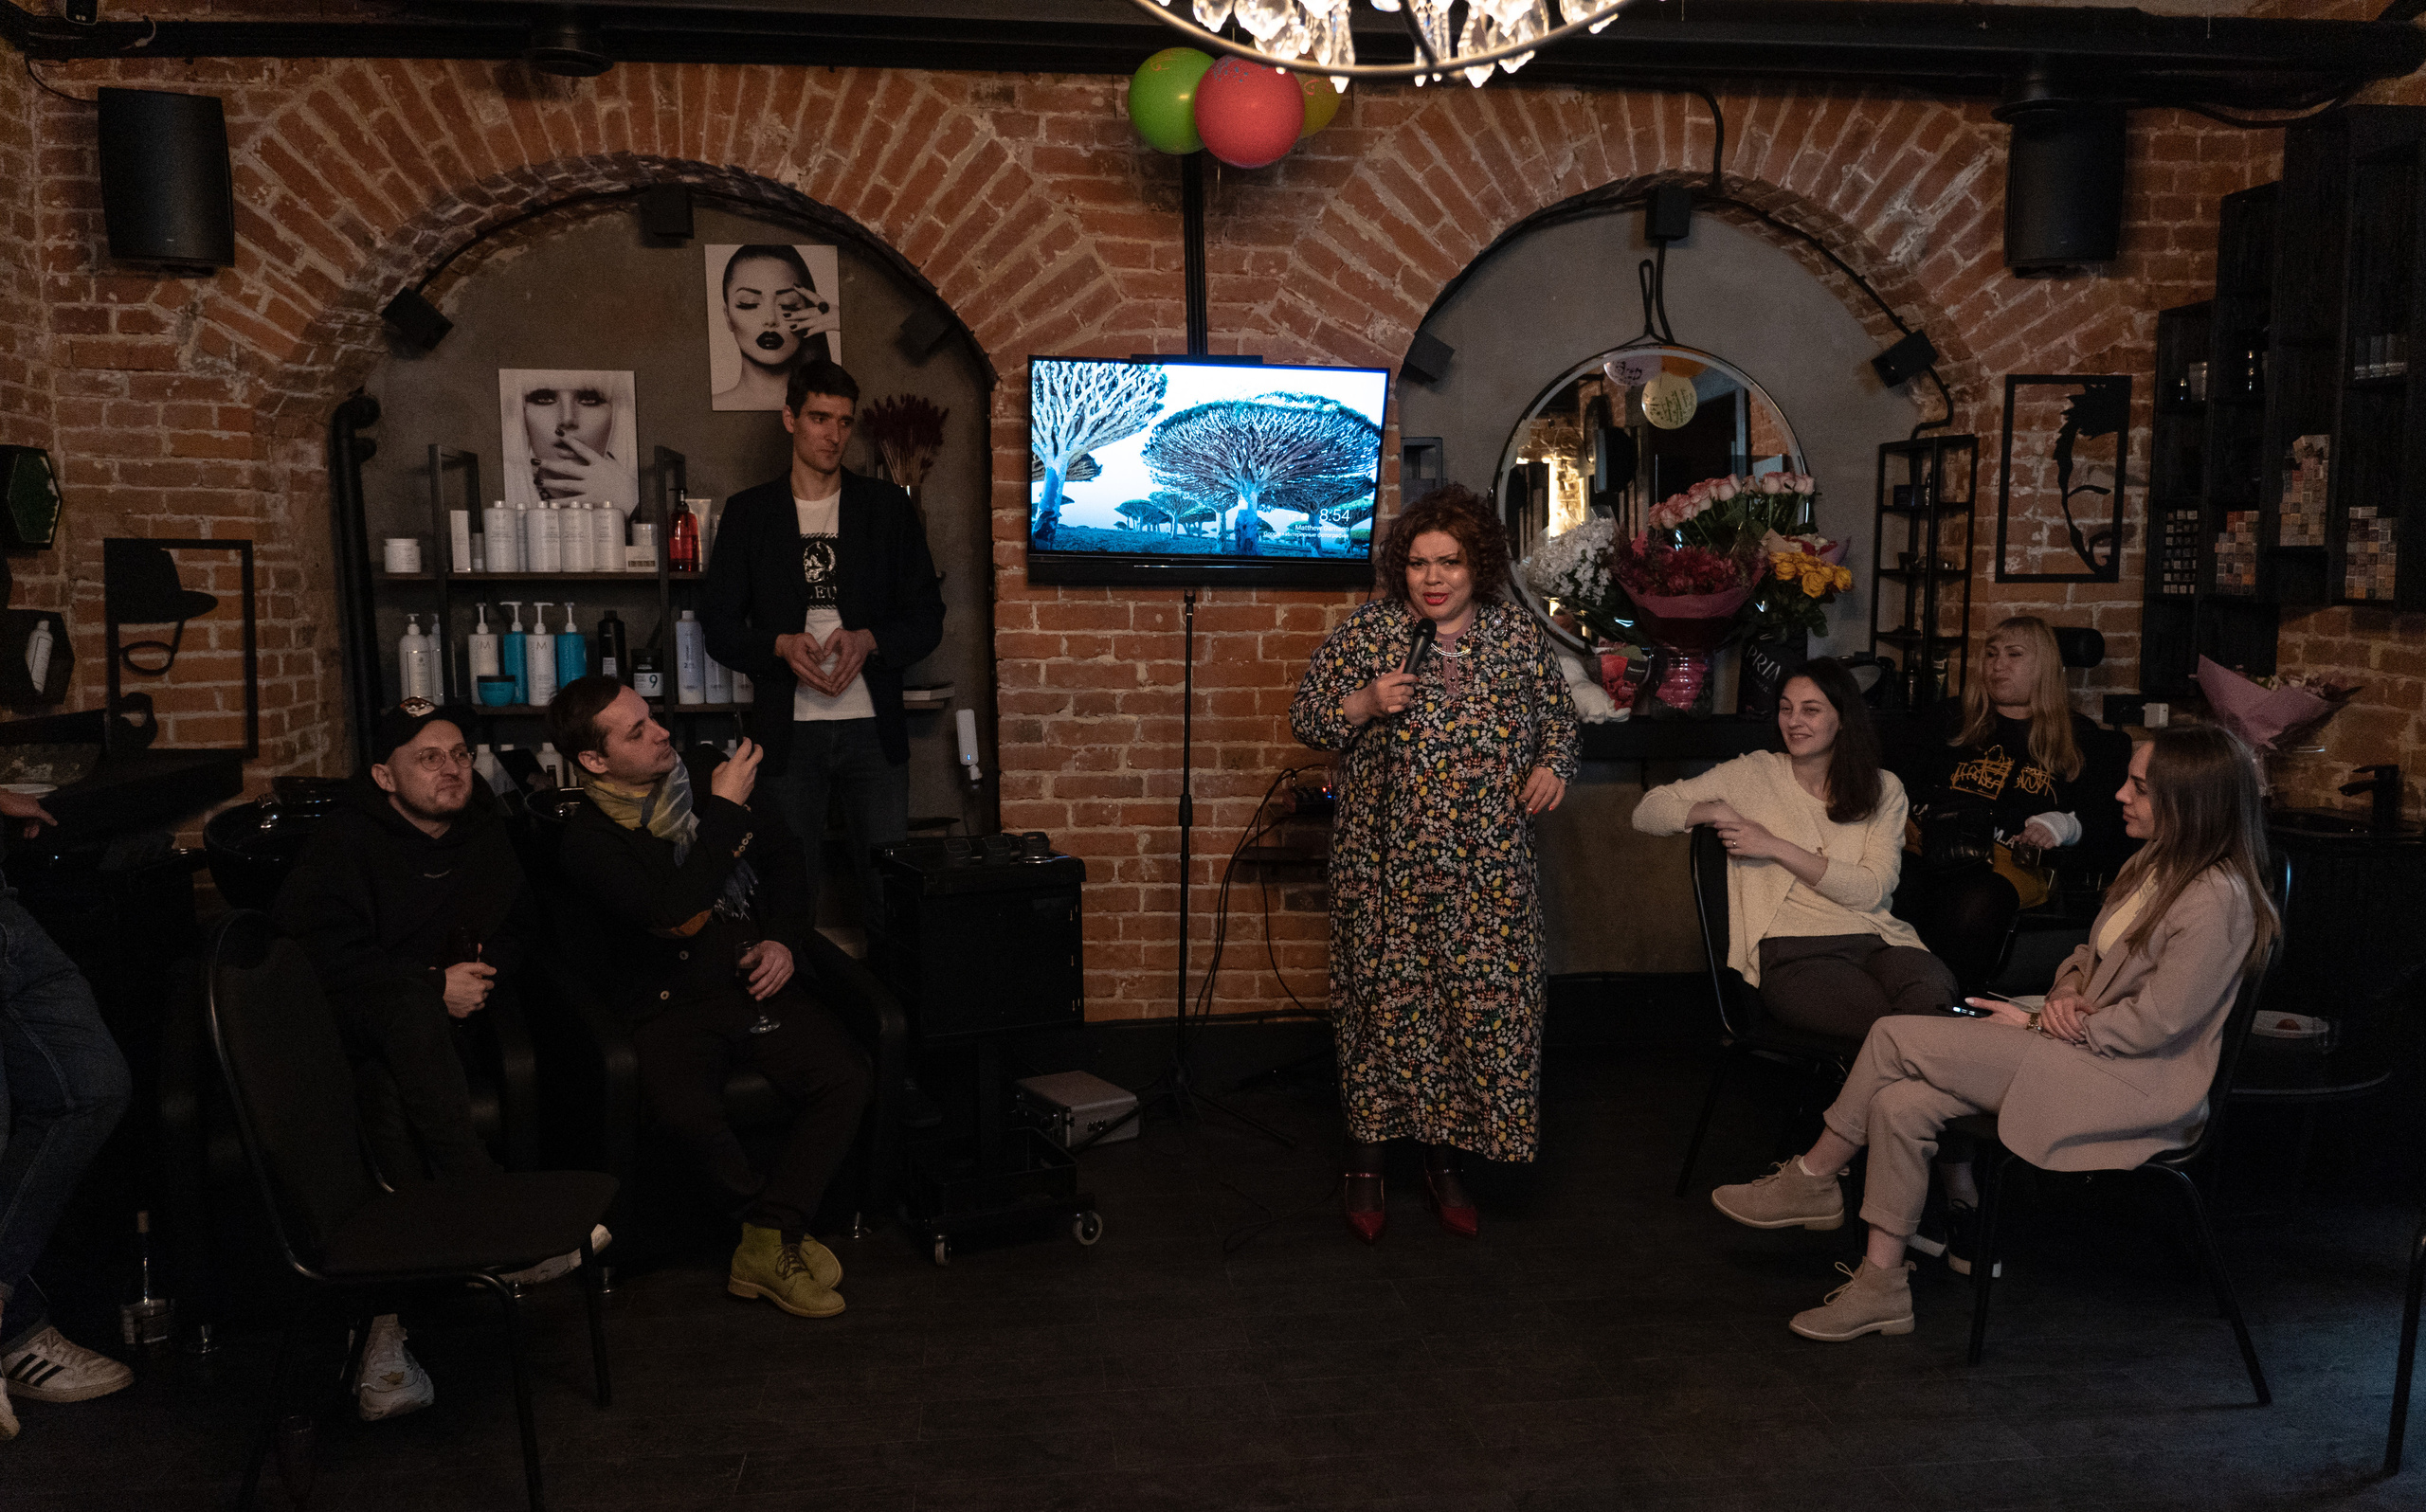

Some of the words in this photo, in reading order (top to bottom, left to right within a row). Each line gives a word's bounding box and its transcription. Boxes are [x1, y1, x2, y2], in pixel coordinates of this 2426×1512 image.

[1319, 509, 1350, 522] 8:54
[536, 640, 548, 650] M
[649, 674, 658, 689] 9
